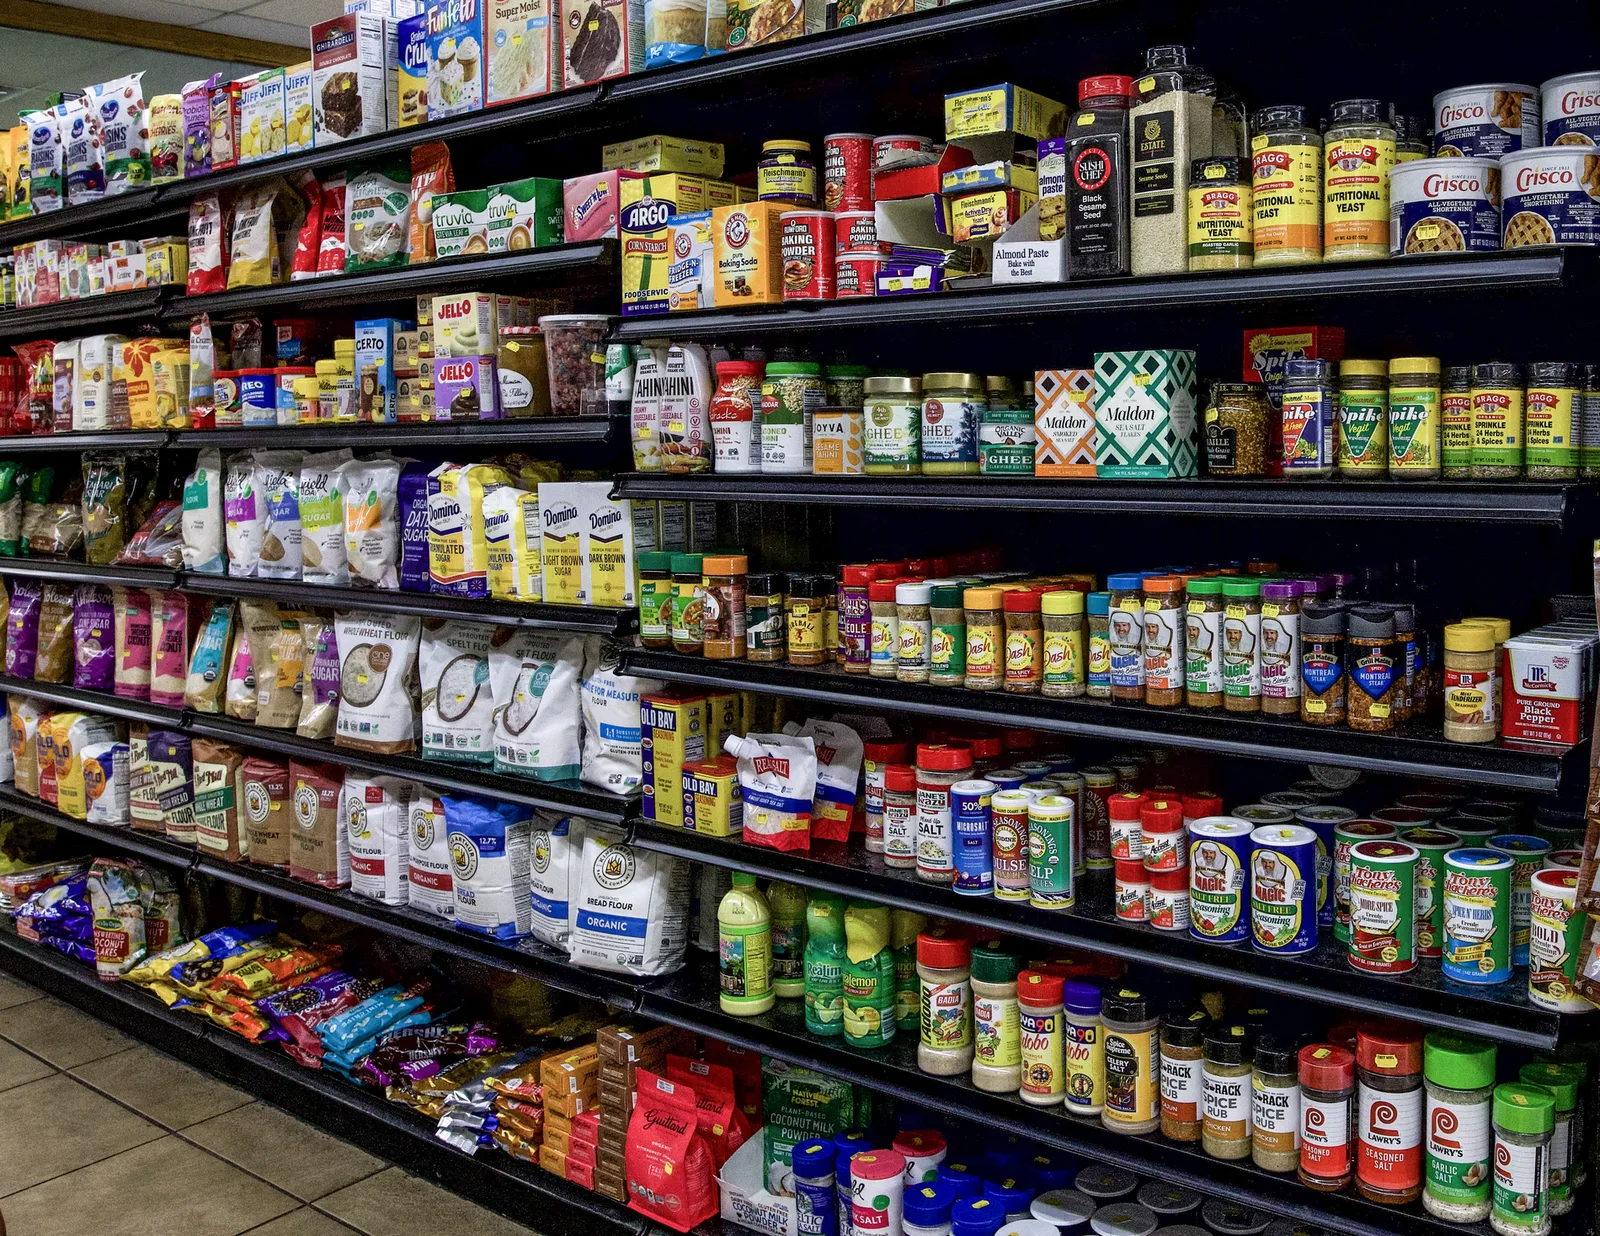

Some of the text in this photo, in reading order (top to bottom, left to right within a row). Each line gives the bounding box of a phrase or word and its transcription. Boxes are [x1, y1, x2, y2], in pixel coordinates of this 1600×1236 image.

[496, 0, 541, 19] Super Moist
[316, 32, 355, 52] GHIRARDELLI
[285, 73, 310, 91] JIFFY
[1440, 105, 1484, 128] Crisco
[1140, 139, 1165, 151] ESTATE
[1079, 160, 1104, 172] SUSHI
[763, 167, 806, 178] Fleischmann's
[1080, 170, 1103, 181] CHEF
[1039, 174, 1065, 186] almond
[1423, 174, 1480, 198] Crisco
[1516, 168, 1573, 192] Crisco
[1042, 183, 1063, 196] paste
[1206, 191, 1235, 200] BRAGG
[1082, 194, 1102, 202] Black
[1327, 191, 1380, 203] NUTRITIONAL
[1520, 193, 1569, 204] ALL-VEGETABLE
[1524, 198, 1564, 208] SHORTENING
[1078, 202, 1106, 211] Sesame
[1336, 202, 1365, 213] YEAST
[628, 204, 668, 228] ARGO
[1083, 210, 1101, 220] Seed
[1257, 208, 1279, 219] YEAST
[1197, 220, 1244, 230] NUTRITIONAL
[1208, 228, 1232, 237] YEAST
[628, 240, 667, 252] CORN STARCH
[781, 234, 813, 246] BAKING
[732, 252, 744, 260] pure
[781, 246, 815, 257] POWDER
[996, 248, 1049, 259] Almond Paste
[668, 258, 699, 276] FRIDGE-N-
[719, 258, 758, 268] Baking Soda
[1008, 260, 1035, 268] Bake with
[668, 268, 694, 284] FREEZER
[1010, 268, 1032, 276] the Best
[438, 300, 471, 320] JELL-O
[356, 338, 384, 351] CERTO
[440, 362, 473, 382] JELL-O
[1476, 394, 1506, 404] BRAGG
[389, 392, 397, 419] CERTO
[1105, 406, 1155, 422] Maldon
[1340, 407, 1384, 424] Spike
[814, 423, 844, 434] JOYVA
[1044, 416, 1088, 430] Maldon
[1116, 424, 1146, 432] SEA SALT
[867, 428, 903, 439] GHEE
[922, 425, 953, 436] GHEE
[815, 442, 840, 451] SESAME
[816, 450, 838, 459] TAHINI
[989, 455, 1033, 464] GHEE
[302, 512, 331, 522] SUGAR
[429, 504, 460, 522] Domino
[544, 506, 578, 527] Domino
[589, 510, 622, 530] Domino
[436, 553, 451, 562] SUGAR
[543, 555, 584, 566] LIGHT BROWN
[588, 553, 626, 564] DARK BROWN
[554, 566, 572, 576] SUGAR
[598, 563, 615, 572] SUGAR
[788, 618, 816, 632] FIREBALL
[360, 628, 383, 638] WHEAT
[446, 639, 472, 649] SPELT
[1304, 653, 1334, 662] Grill Mates
[1360, 657, 1392, 666] Grill Mates
[312, 667, 339, 682] SUGAR
[1304, 668, 1334, 677] MONTREAL
[1360, 673, 1391, 681] MONTREAL
[1523, 680, 1553, 689] McCormick
[591, 697, 608, 707] FLOUR
[1450, 695, 1482, 703] TENDERIZER
[1532, 700, 1560, 708] GROUND
[1524, 706, 1552, 716] Black
[640, 708, 676, 730] OLD BAY
[1520, 712, 1556, 725] Pepper
[606, 727, 616, 738] 1:1
[682, 776, 716, 796] OLD BAY
[918, 792, 946, 801] JANE'S
[962, 801, 982, 812] 50%
[171, 804, 194, 824] FLOUR
[206, 812, 225, 831] FLOUR
[956, 822, 988, 832] MICROSALT
[259, 830, 280, 840] WHEAT
[888, 826, 907, 836] SALT
[919, 822, 944, 836] SALT
[480, 836, 497, 846] 12.7%
[362, 848, 382, 856] FLOUR
[413, 872, 438, 886] ORGANIC
[1194, 875, 1226, 892] MAGIC
[457, 887, 476, 899] BREAD
[1208, 893, 1231, 903] FREE
[1255, 886, 1286, 903] MAGIC
[457, 894, 476, 906] FLOUR
[587, 898, 633, 911] BREAD FLOUR
[1374, 899, 1394, 913] SPICE
[1194, 902, 1232, 916] Seasoning
[1472, 907, 1492, 920] HERBS
[587, 916, 628, 931] ORGANIC
[1254, 911, 1291, 928] Seasoning
[1532, 924, 1558, 944] BOLD
[938, 994, 960, 1006] BADIA
[1110, 1038, 1126, 1048] Spice
[1107, 1056, 1130, 1068] CELERY
[1110, 1064, 1125, 1072] SALT
[1214, 1083, 1242, 1096] RACK
[1204, 1093, 1237, 1109] SPICE
[780, 1106, 826, 1120] PLANT-BASED
[1207, 1106, 1228, 1119] RUB
[644, 1108, 689, 1136] Guittard
[770, 1113, 834, 1134] COCONUT MILK
[1205, 1120, 1231, 1132] CHICKEN
[1254, 1131, 1279, 1144] CHICKEN
[1368, 1133, 1401, 1144] LAWRY'S
[1303, 1143, 1330, 1156] SEASONED
[1366, 1148, 1404, 1162] SEASONED
[1430, 1142, 1464, 1158] LAWRY'S
[1308, 1152, 1322, 1162] SALT
[1374, 1160, 1394, 1172] SALT
[1432, 1160, 1458, 1176] GARLIC
[1434, 1170, 1453, 1184] SALT
[732, 1202, 789, 1226] COCONUT MILK
[862, 1215, 883, 1225] SALT
[743, 1213, 778, 1229] POWDER
